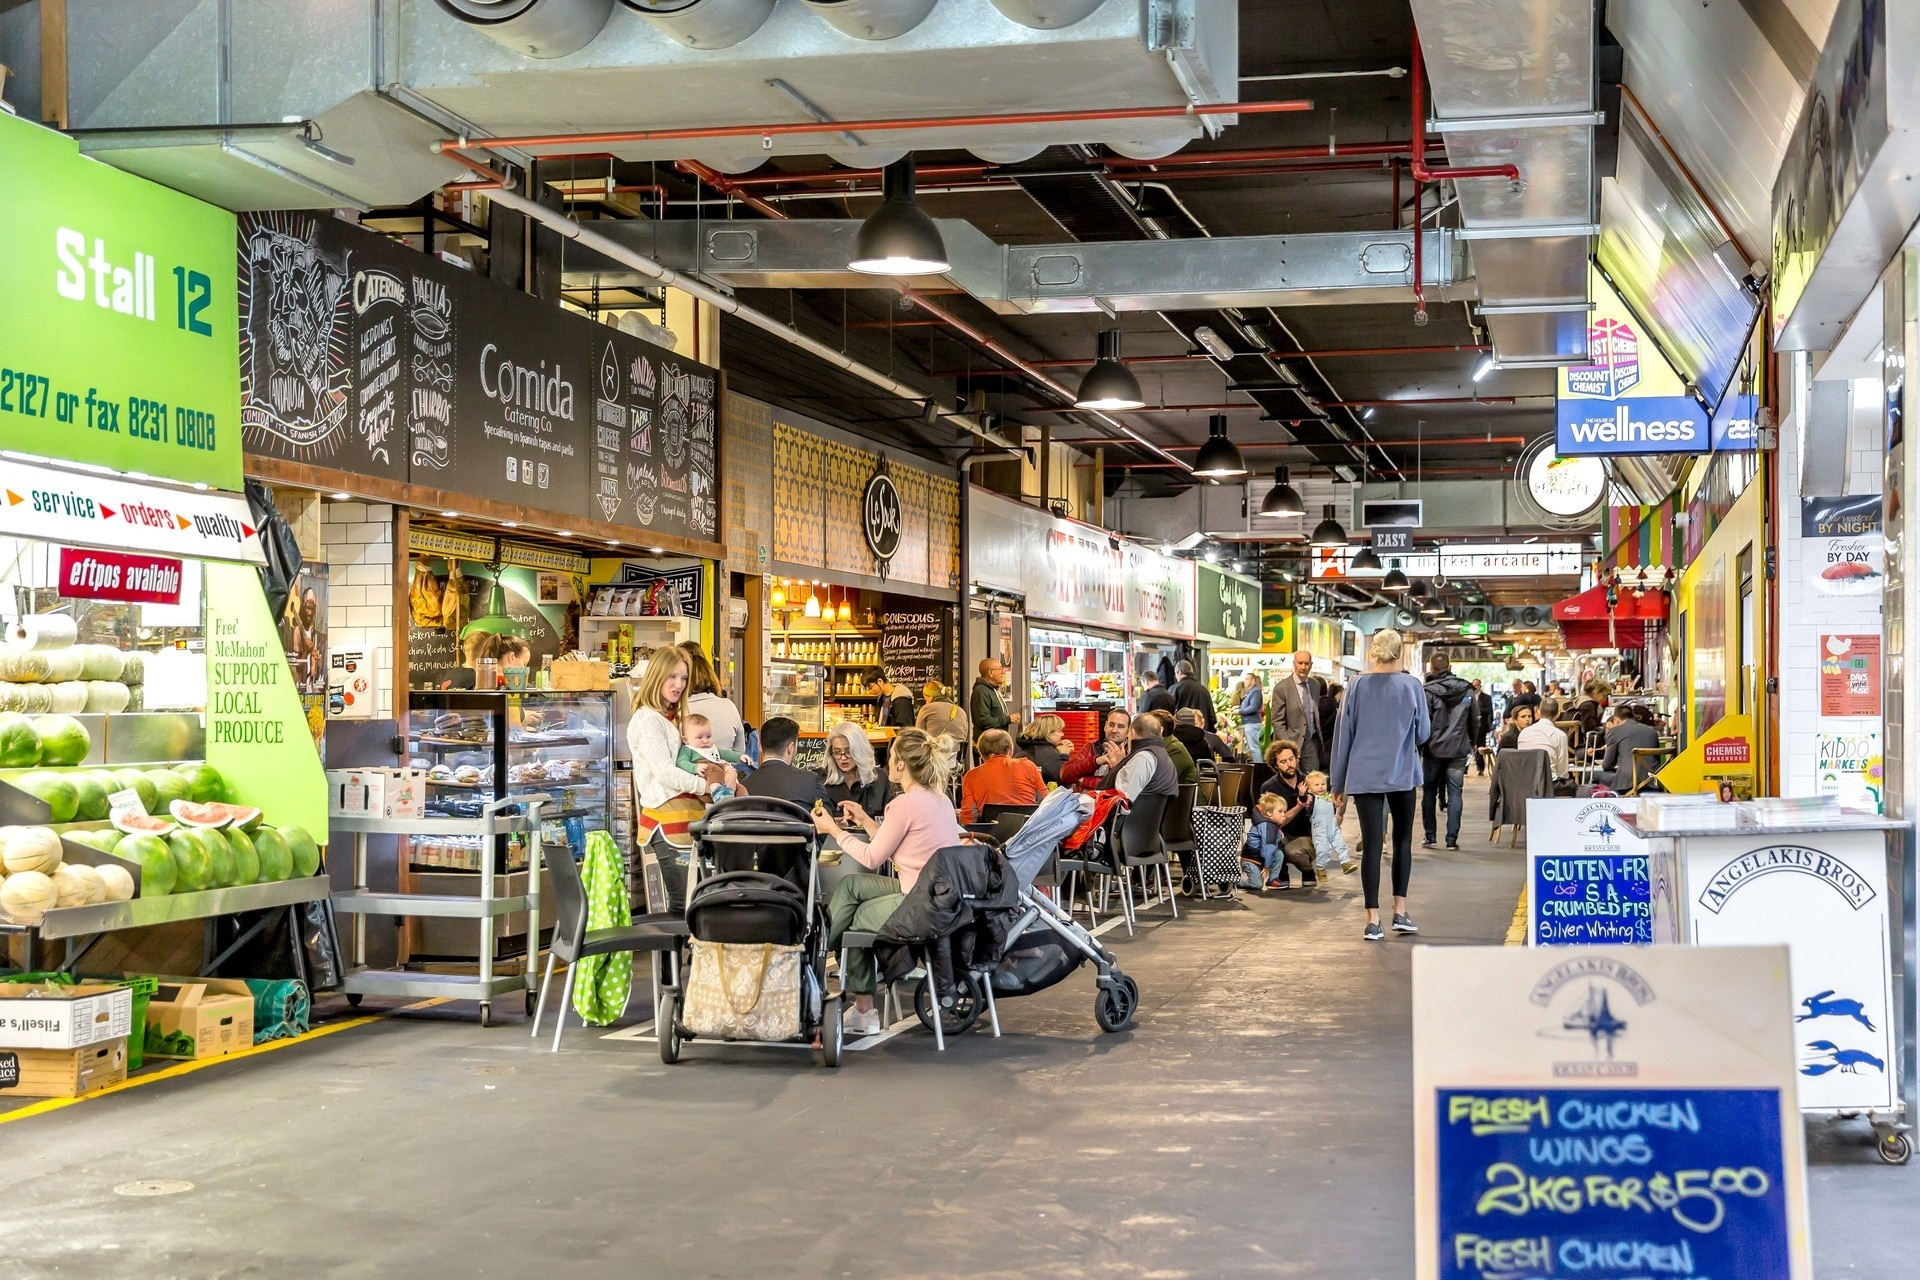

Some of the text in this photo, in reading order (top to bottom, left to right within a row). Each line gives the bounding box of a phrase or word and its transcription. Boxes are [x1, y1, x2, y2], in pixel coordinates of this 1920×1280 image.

[56, 226, 213, 337] Stall 12
[353, 271, 405, 314] CATERING
[361, 316, 393, 353] WEDDINGS
[480, 343, 574, 421] Comida
[1569, 371, 1609, 382] DISCOUNT
[1573, 382, 1606, 394] CHEMIST
[0, 368, 216, 451] 2127 or fax 8231 0808
[504, 406, 553, 434] Catering Co.
[290, 429, 317, 440] SPANISH
[1570, 405, 1695, 443] wellness
[484, 421, 574, 457] Specialising in Spanish tapas and paella
[32, 490, 242, 543] service orders quality
[1818, 522, 1878, 533] BY NIGHT
[1377, 533, 1406, 547] EAST
[1828, 539, 1868, 551] Fresher
[1483, 554, 1540, 567] arcade
[1827, 552, 1871, 562] BY DAY
[70, 558, 180, 594] eftpos available
[1135, 588, 1167, 622] UTCHERS
[883, 631, 918, 648] Lamb
[215, 663, 279, 685] SUPPORT
[215, 691, 262, 714] LOCAL
[215, 720, 283, 743] PRODUCE
[1706, 746, 1748, 756] CHEMIST
[1820, 740, 1869, 758] KIDDO
[1819, 758, 1868, 770] MARKETS
[1542, 857, 1649, 882] GLUTEN-FR
[1707, 848, 1865, 907] ANGELAKIS BROS.
[1543, 901, 1620, 917] CRUMBED
[1540, 921, 1584, 939] Silver
[1587, 919, 1634, 945] Whiting
[11, 1019, 60, 1032] Filsell's
[1448, 1095, 1700, 1133] FRESH CHICKEN
[1529, 1134, 1653, 1167] WINGS
[1585, 1176, 1654, 1213] FOR
[1455, 1233, 1695, 1275] FRESH CHICKEN
